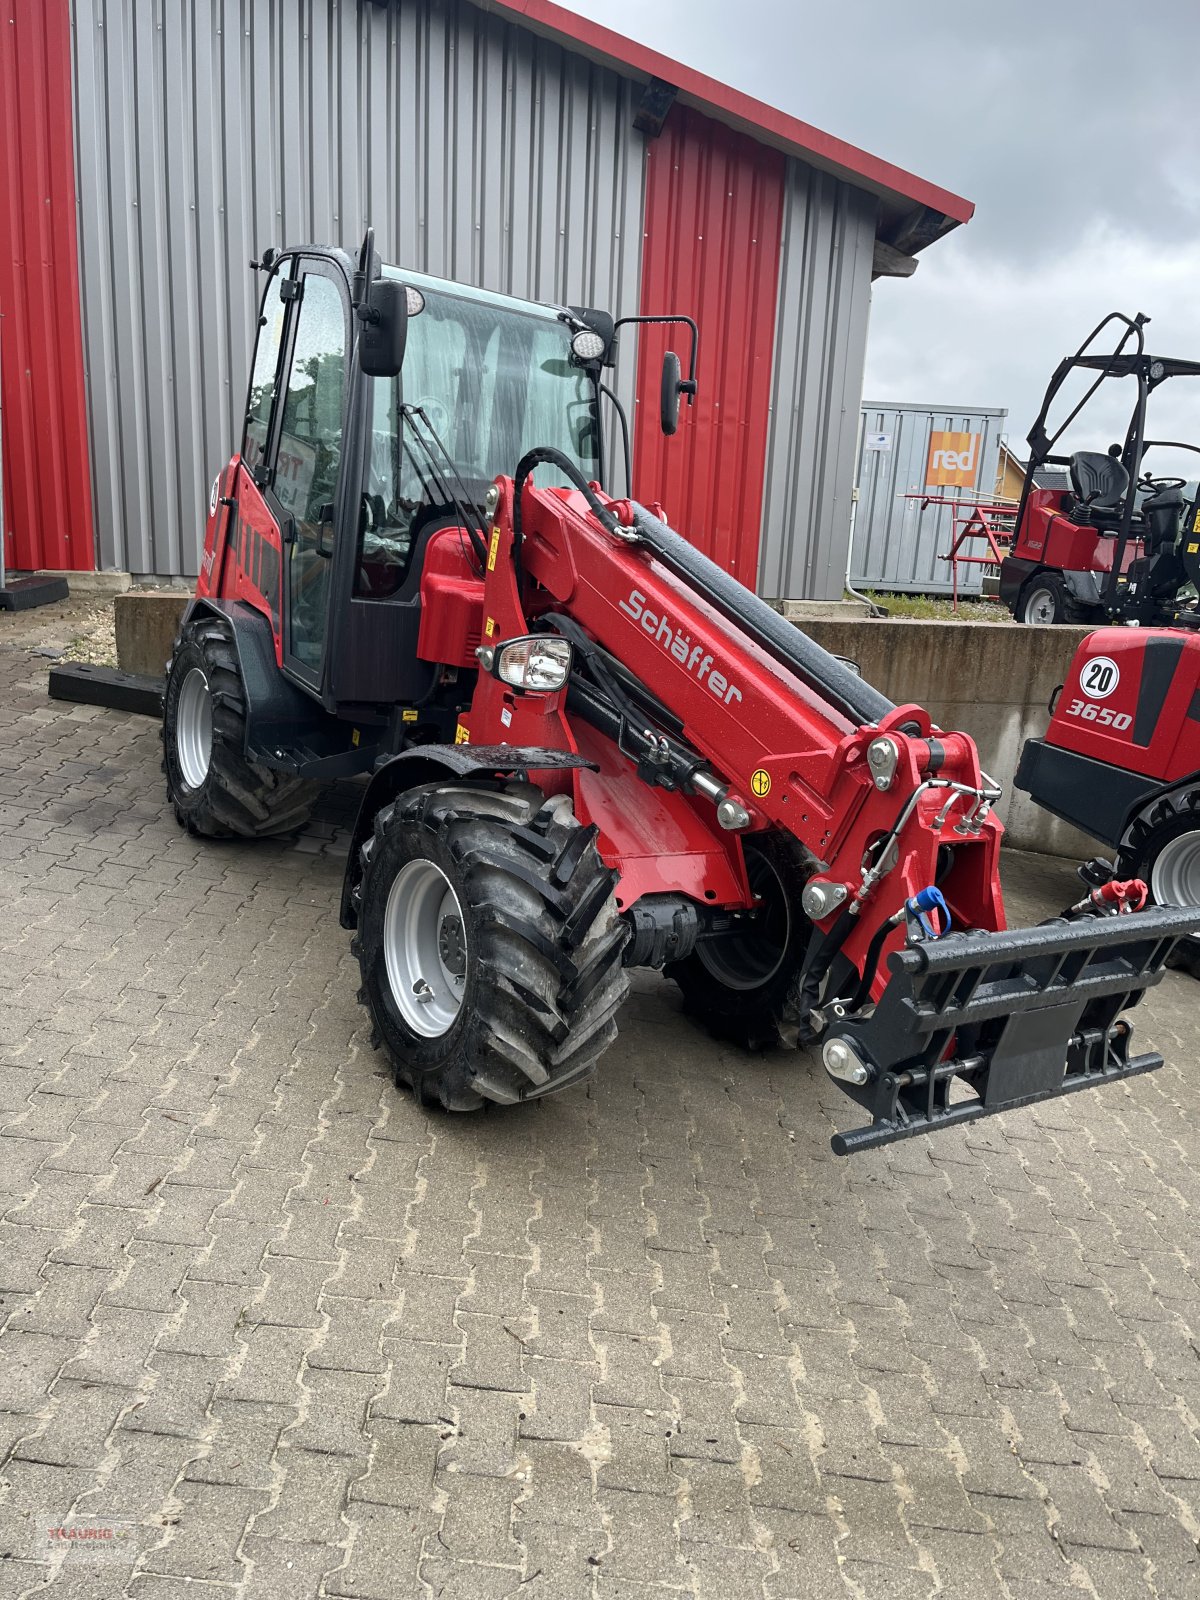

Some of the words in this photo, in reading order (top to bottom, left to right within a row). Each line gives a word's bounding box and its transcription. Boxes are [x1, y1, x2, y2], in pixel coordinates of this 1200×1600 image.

[932, 432, 976, 469] red
[618, 589, 743, 705] Schäffer
[1085, 663, 1113, 692] 20
[1065, 698, 1133, 731] 3650
